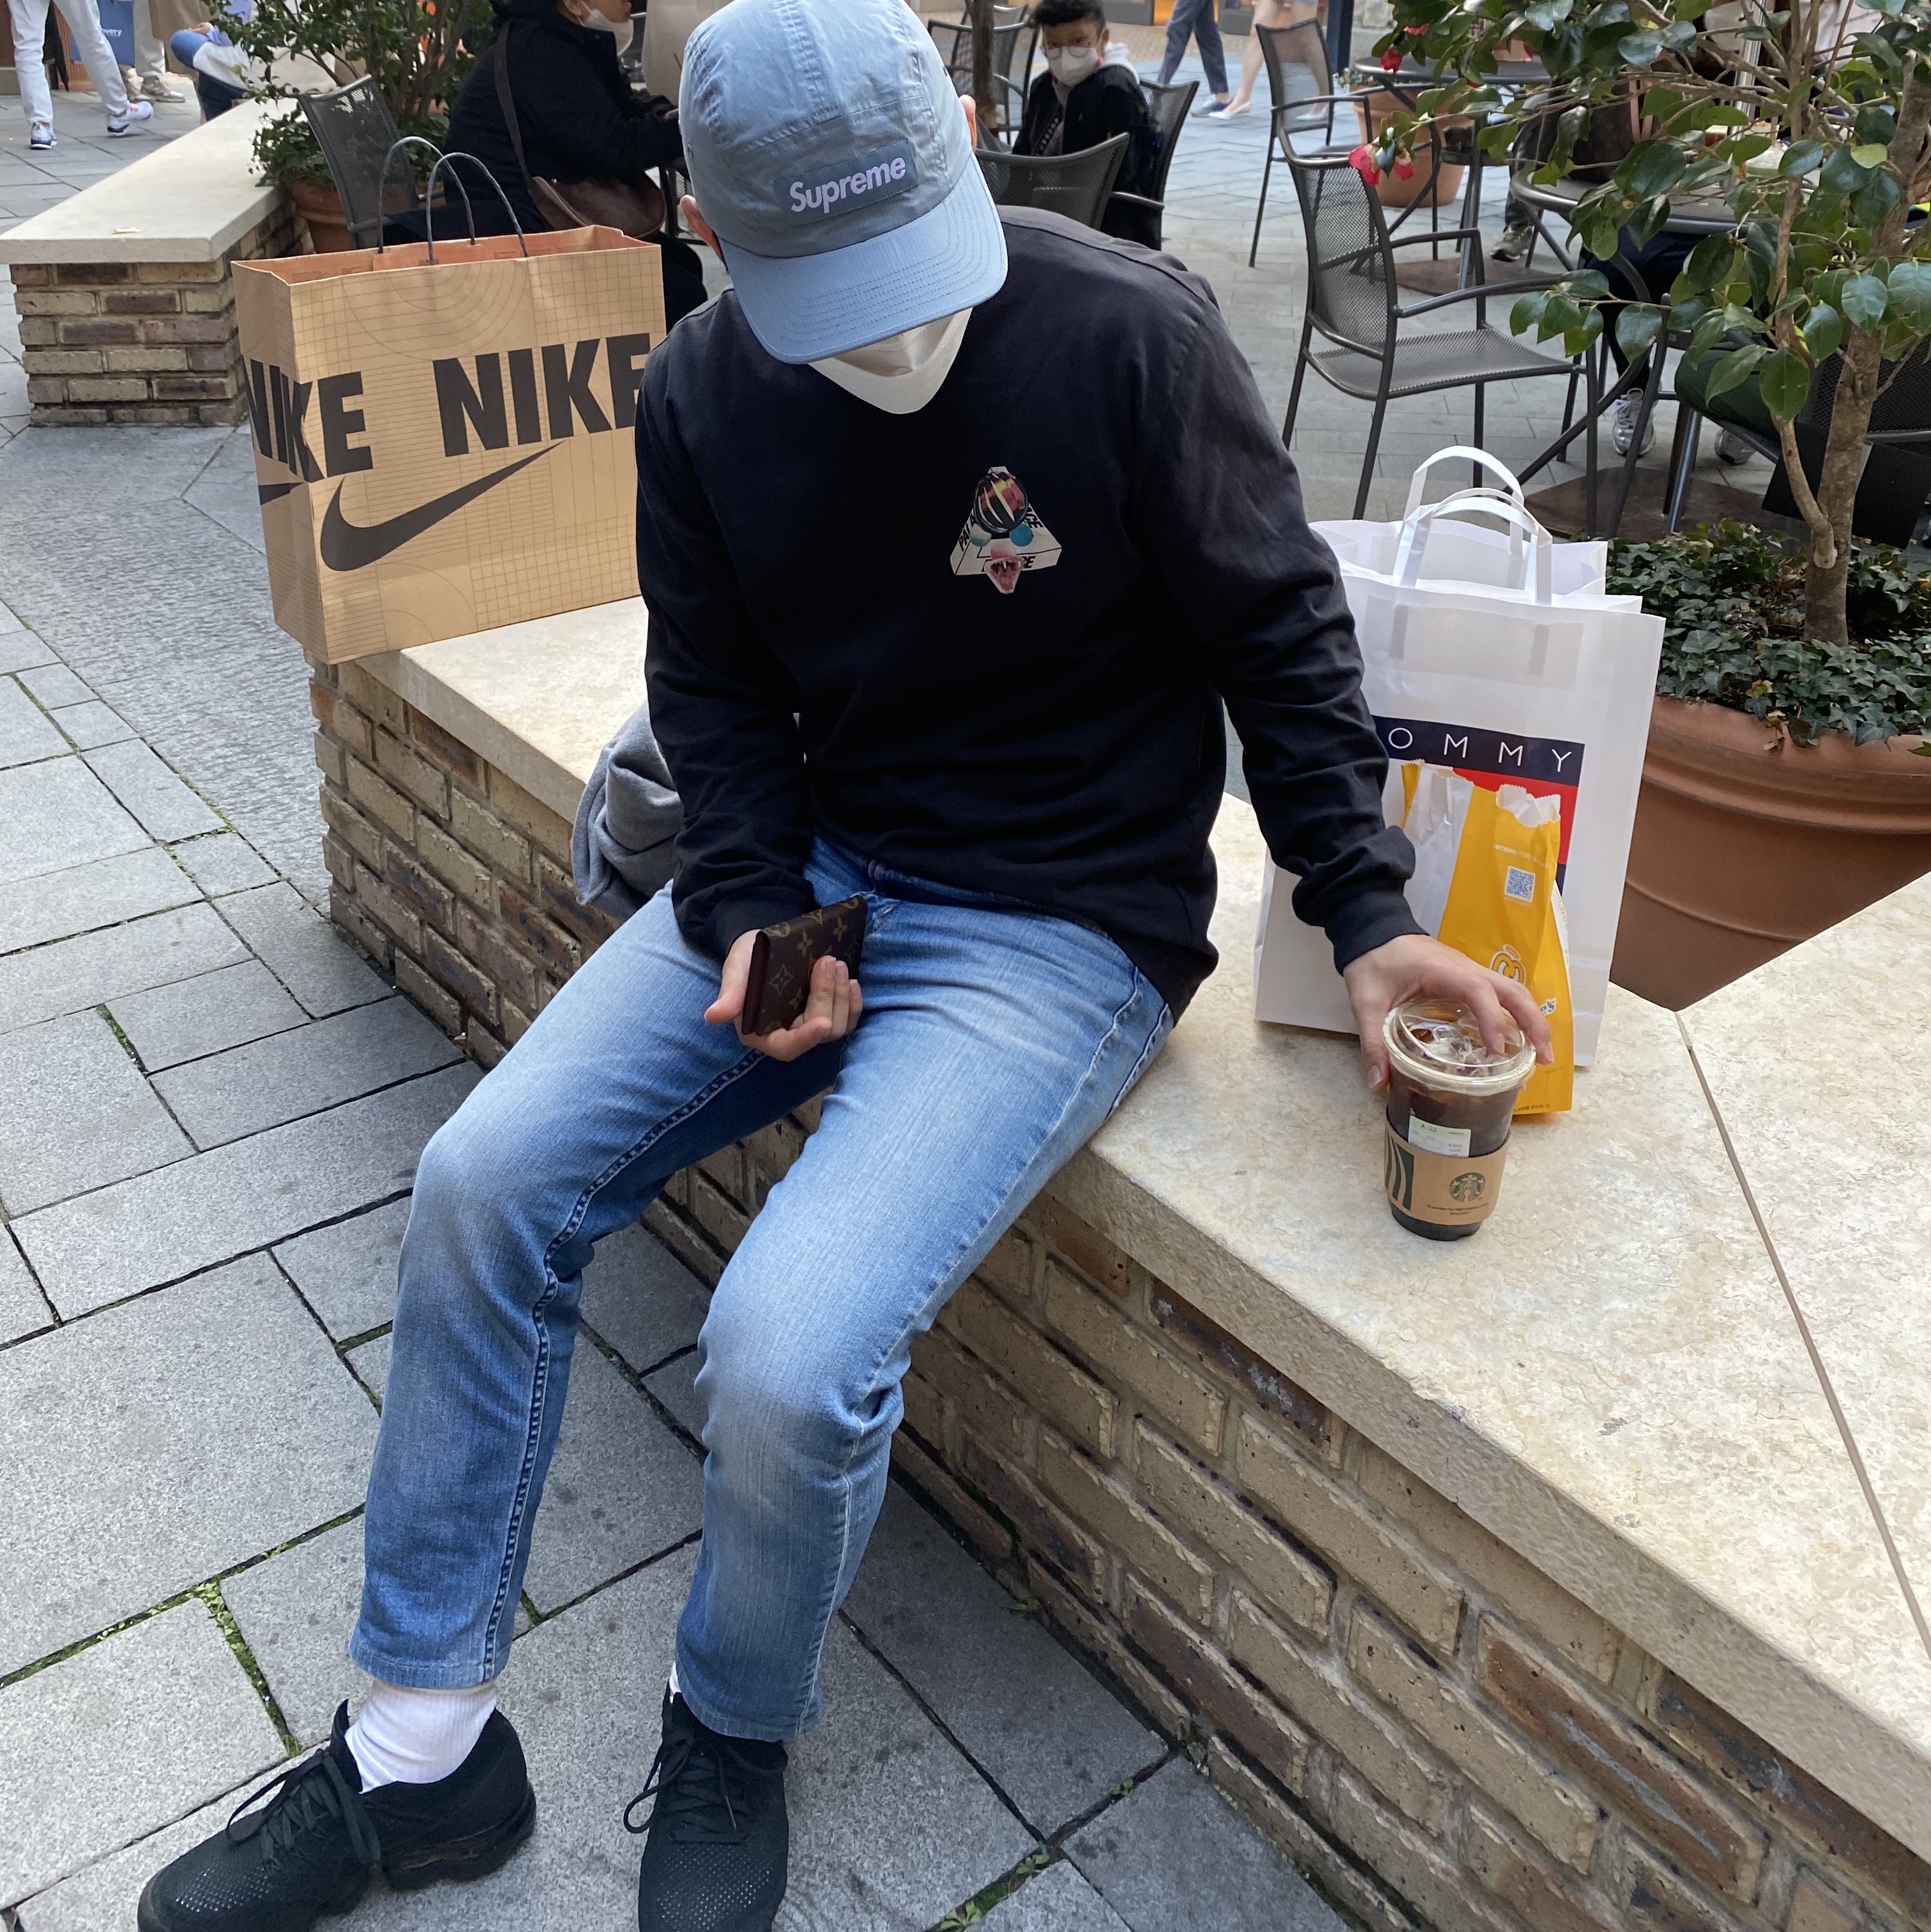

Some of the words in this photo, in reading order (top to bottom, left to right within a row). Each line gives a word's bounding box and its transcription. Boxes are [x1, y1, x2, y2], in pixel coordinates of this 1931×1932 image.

[789, 157, 906, 214] Supreme
[243, 355, 374, 483] NIKE
[432, 333, 651, 458] NIKE
[1388, 727, 1572, 772] OMMY
